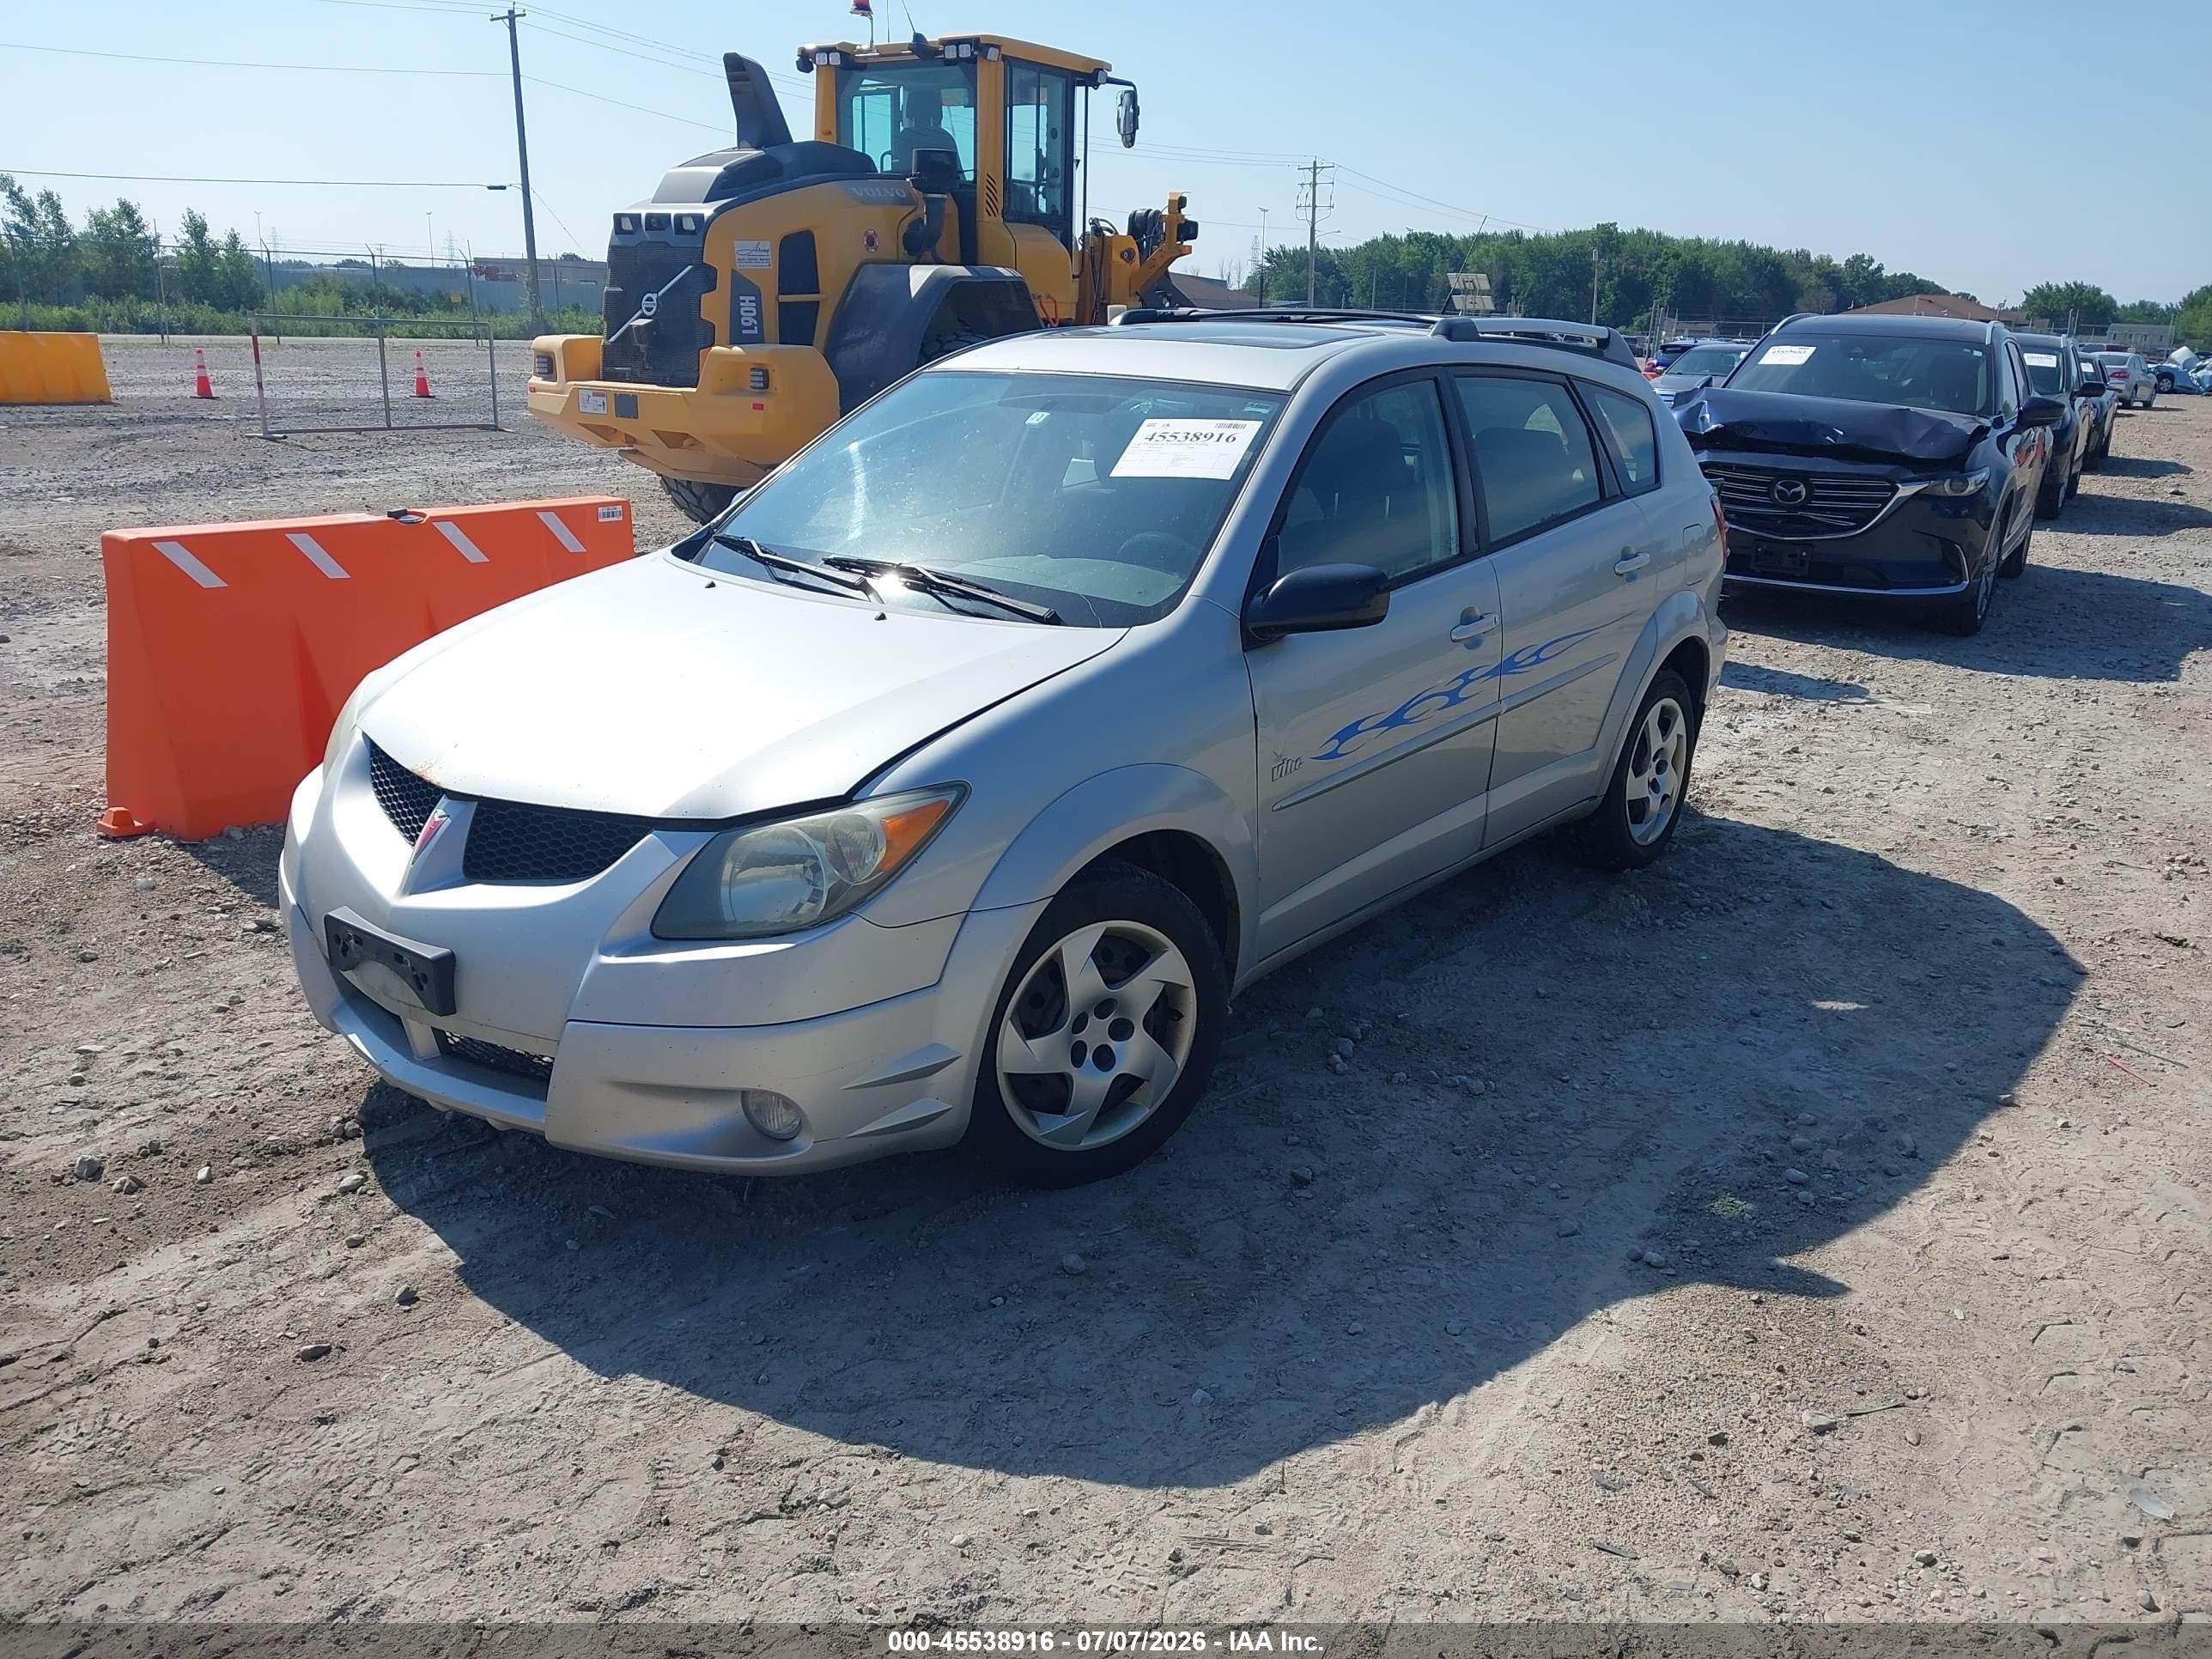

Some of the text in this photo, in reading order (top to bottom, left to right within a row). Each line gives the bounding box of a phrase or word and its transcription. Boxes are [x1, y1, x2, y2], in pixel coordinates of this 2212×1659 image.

[850, 186, 908, 198] VOLVO
[739, 295, 758, 334] L90H
[1144, 431, 1241, 444] 45538916
